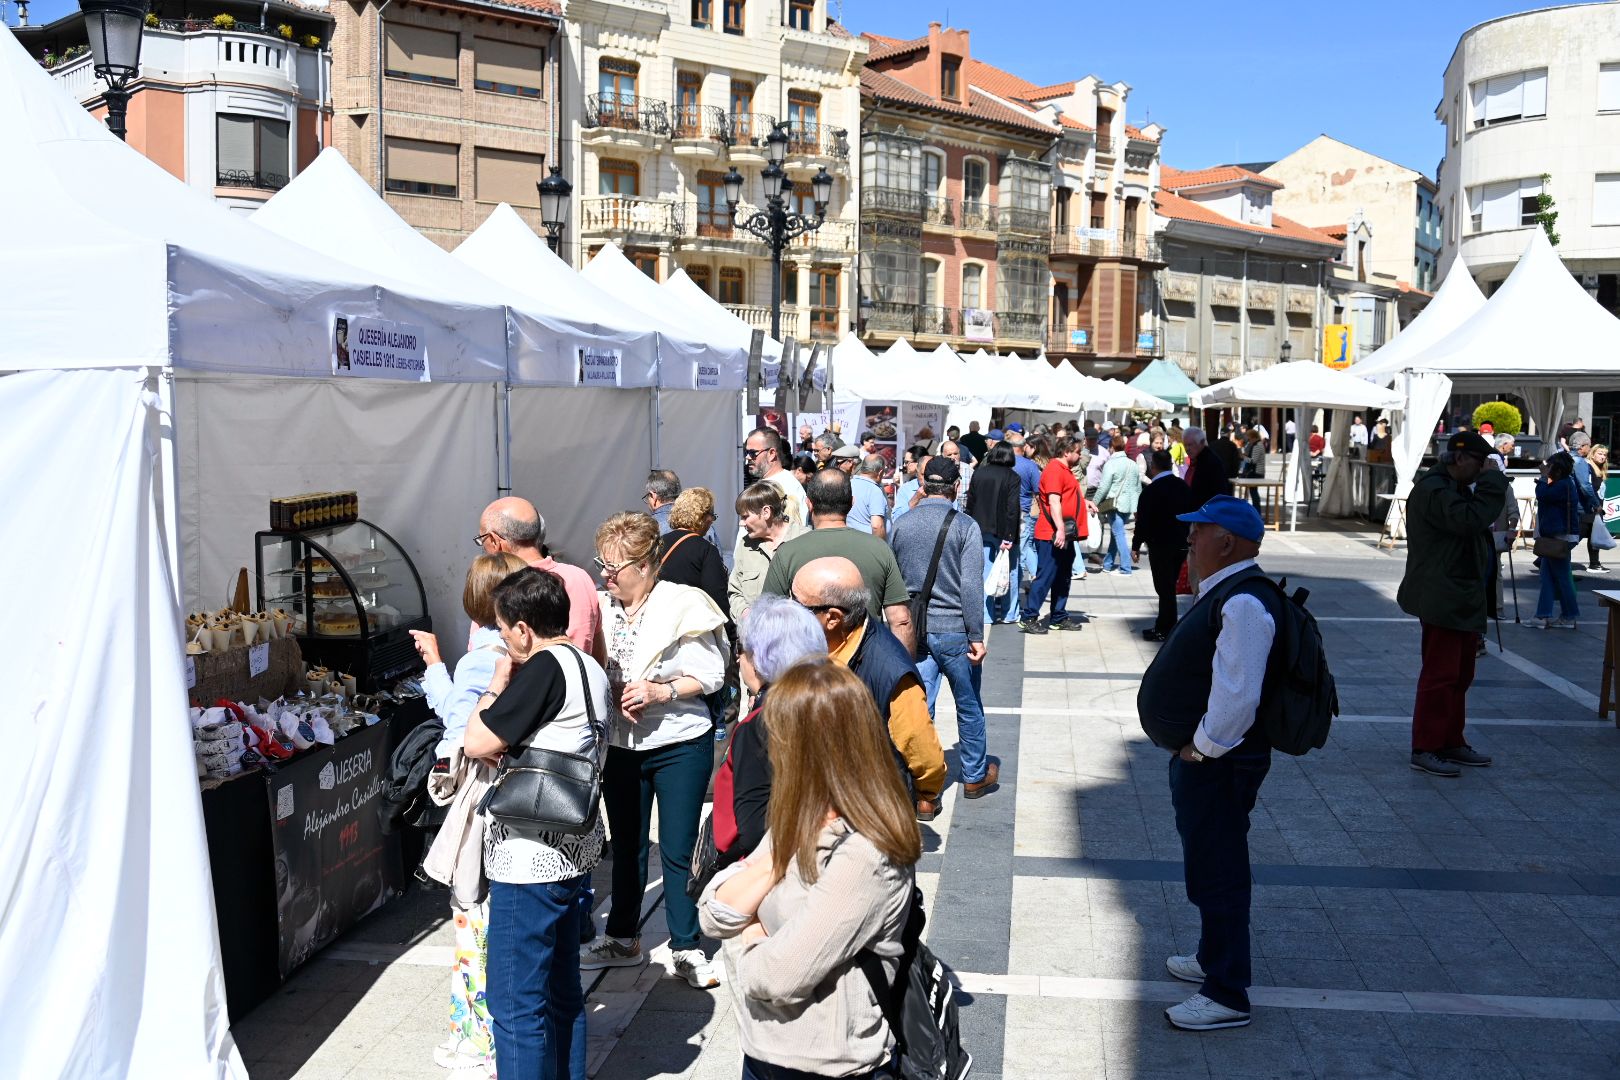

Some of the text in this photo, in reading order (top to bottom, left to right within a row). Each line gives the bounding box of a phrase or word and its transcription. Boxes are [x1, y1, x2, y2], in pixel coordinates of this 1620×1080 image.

[359, 326, 417, 351] QUESERÍA ALEJANDRO
[353, 348, 382, 367] CASIELLES
[303, 797, 350, 841] Alejandro
